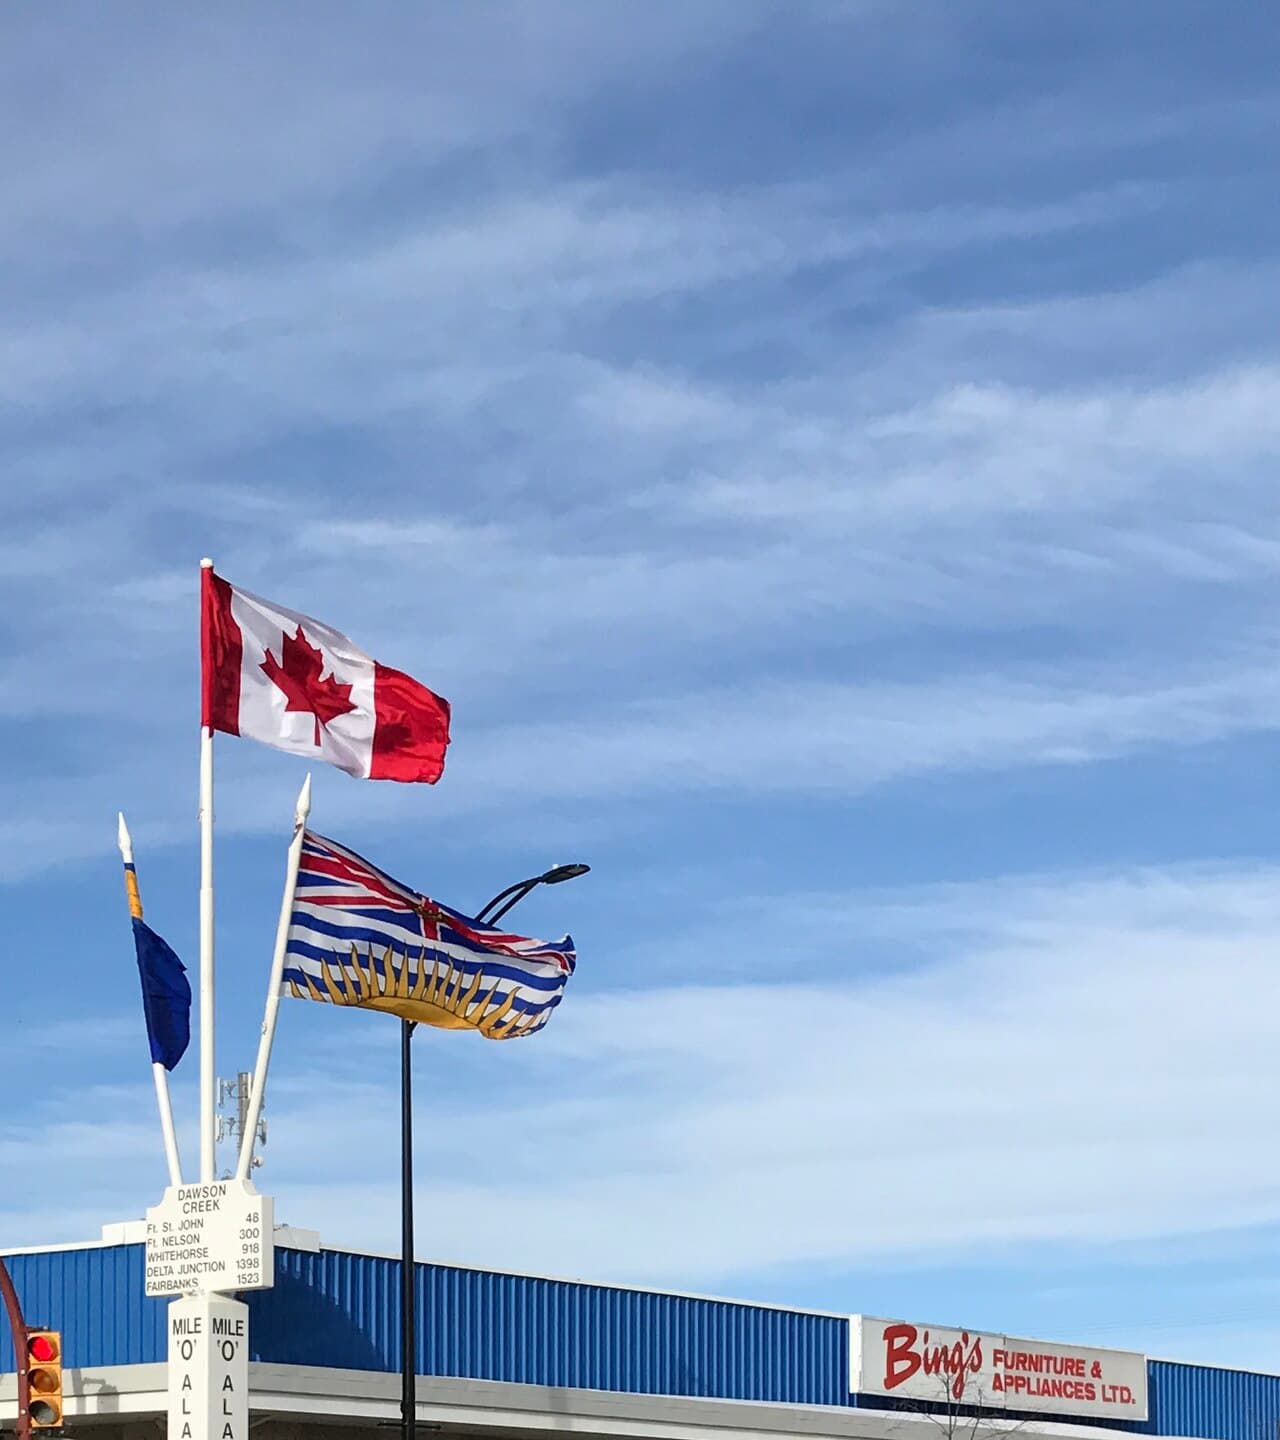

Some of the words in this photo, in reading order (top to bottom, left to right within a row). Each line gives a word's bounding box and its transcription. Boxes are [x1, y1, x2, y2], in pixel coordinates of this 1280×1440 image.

[178, 1184, 226, 1201] DAWSON
[182, 1199, 220, 1214] CREEK
[178, 1218, 204, 1232] JOHN
[162, 1233, 200, 1248] NELSON
[240, 1228, 260, 1240] 300
[148, 1247, 209, 1262] WHITEHORSE
[242, 1242, 260, 1254] 918
[147, 1266, 174, 1278] DELTA
[178, 1261, 226, 1275] JUNCTION
[236, 1258, 260, 1270] 1398
[147, 1278, 199, 1292] FAIRBANKS
[237, 1272, 260, 1284] 1523
[172, 1317, 202, 1335] MILE
[212, 1318, 244, 1336] MILE
[882, 1324, 982, 1399] Bing's
[992, 1348, 1086, 1377] FURNITURE
[1090, 1360, 1102, 1379] &
[992, 1373, 1096, 1400] APPLIANCES
[1101, 1384, 1136, 1404] LTD.
